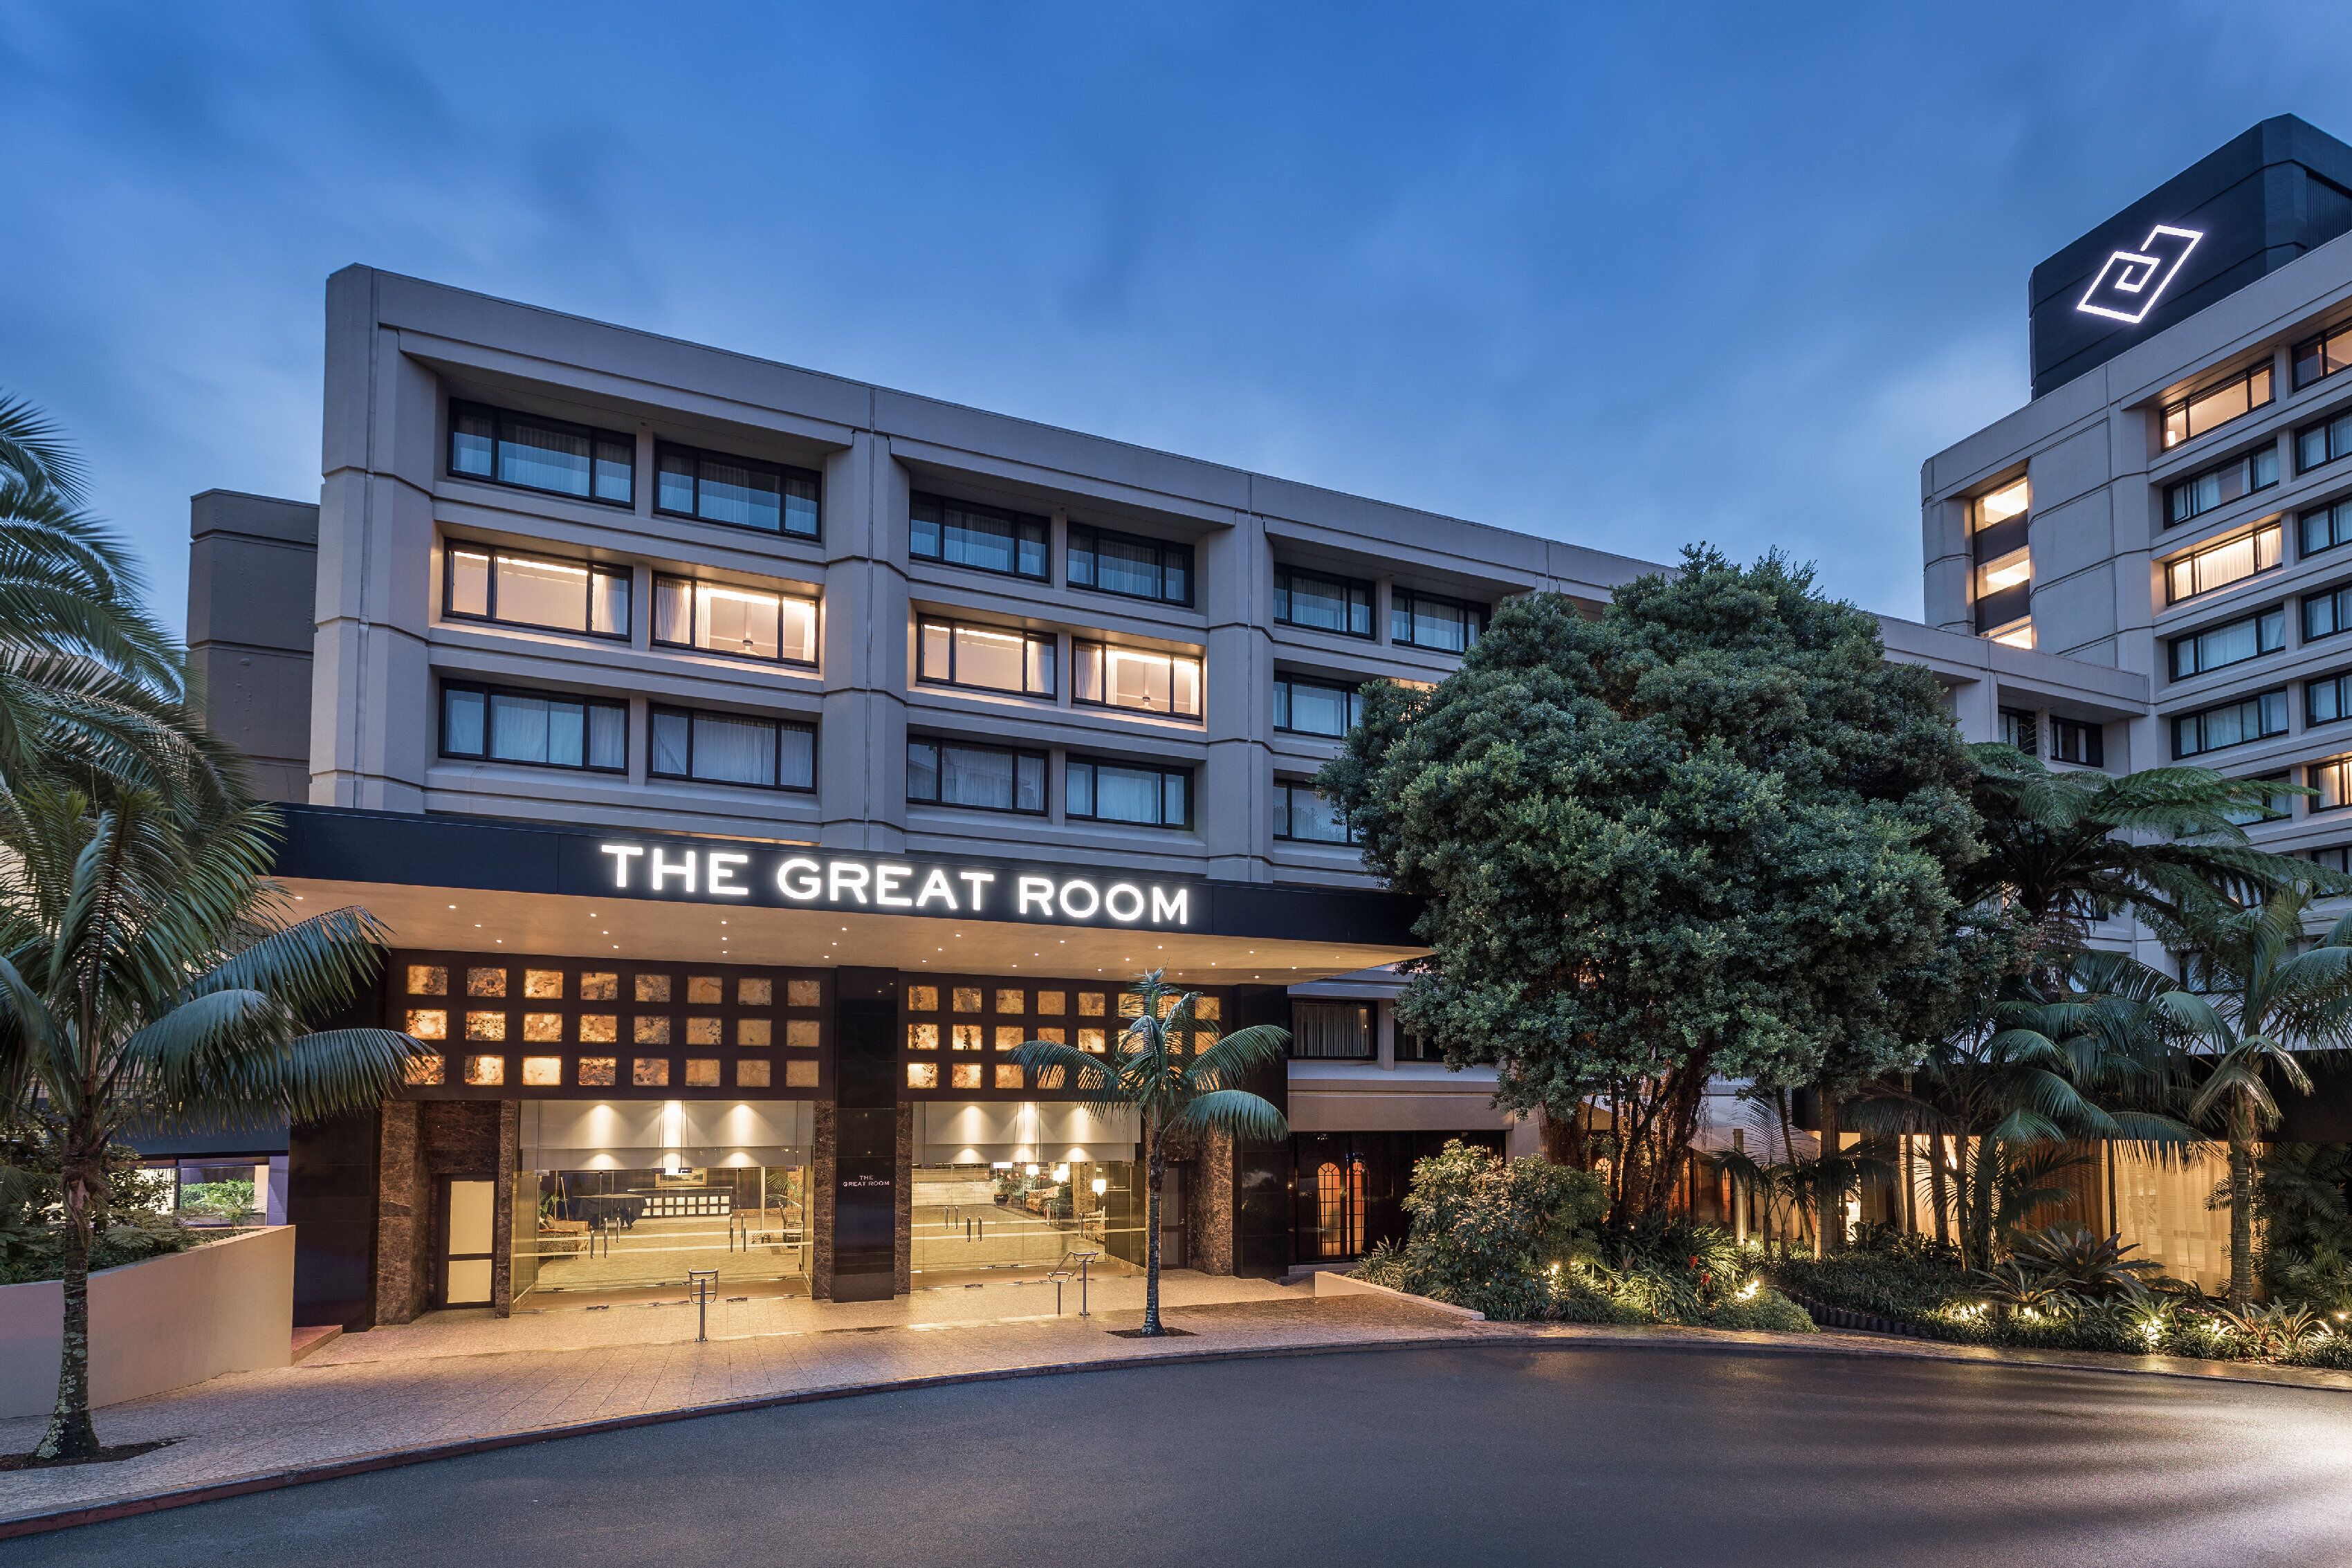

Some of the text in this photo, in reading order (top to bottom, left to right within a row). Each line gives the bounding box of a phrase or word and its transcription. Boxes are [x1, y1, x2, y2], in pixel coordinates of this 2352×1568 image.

[601, 844, 1188, 925] THE GREAT ROOM
